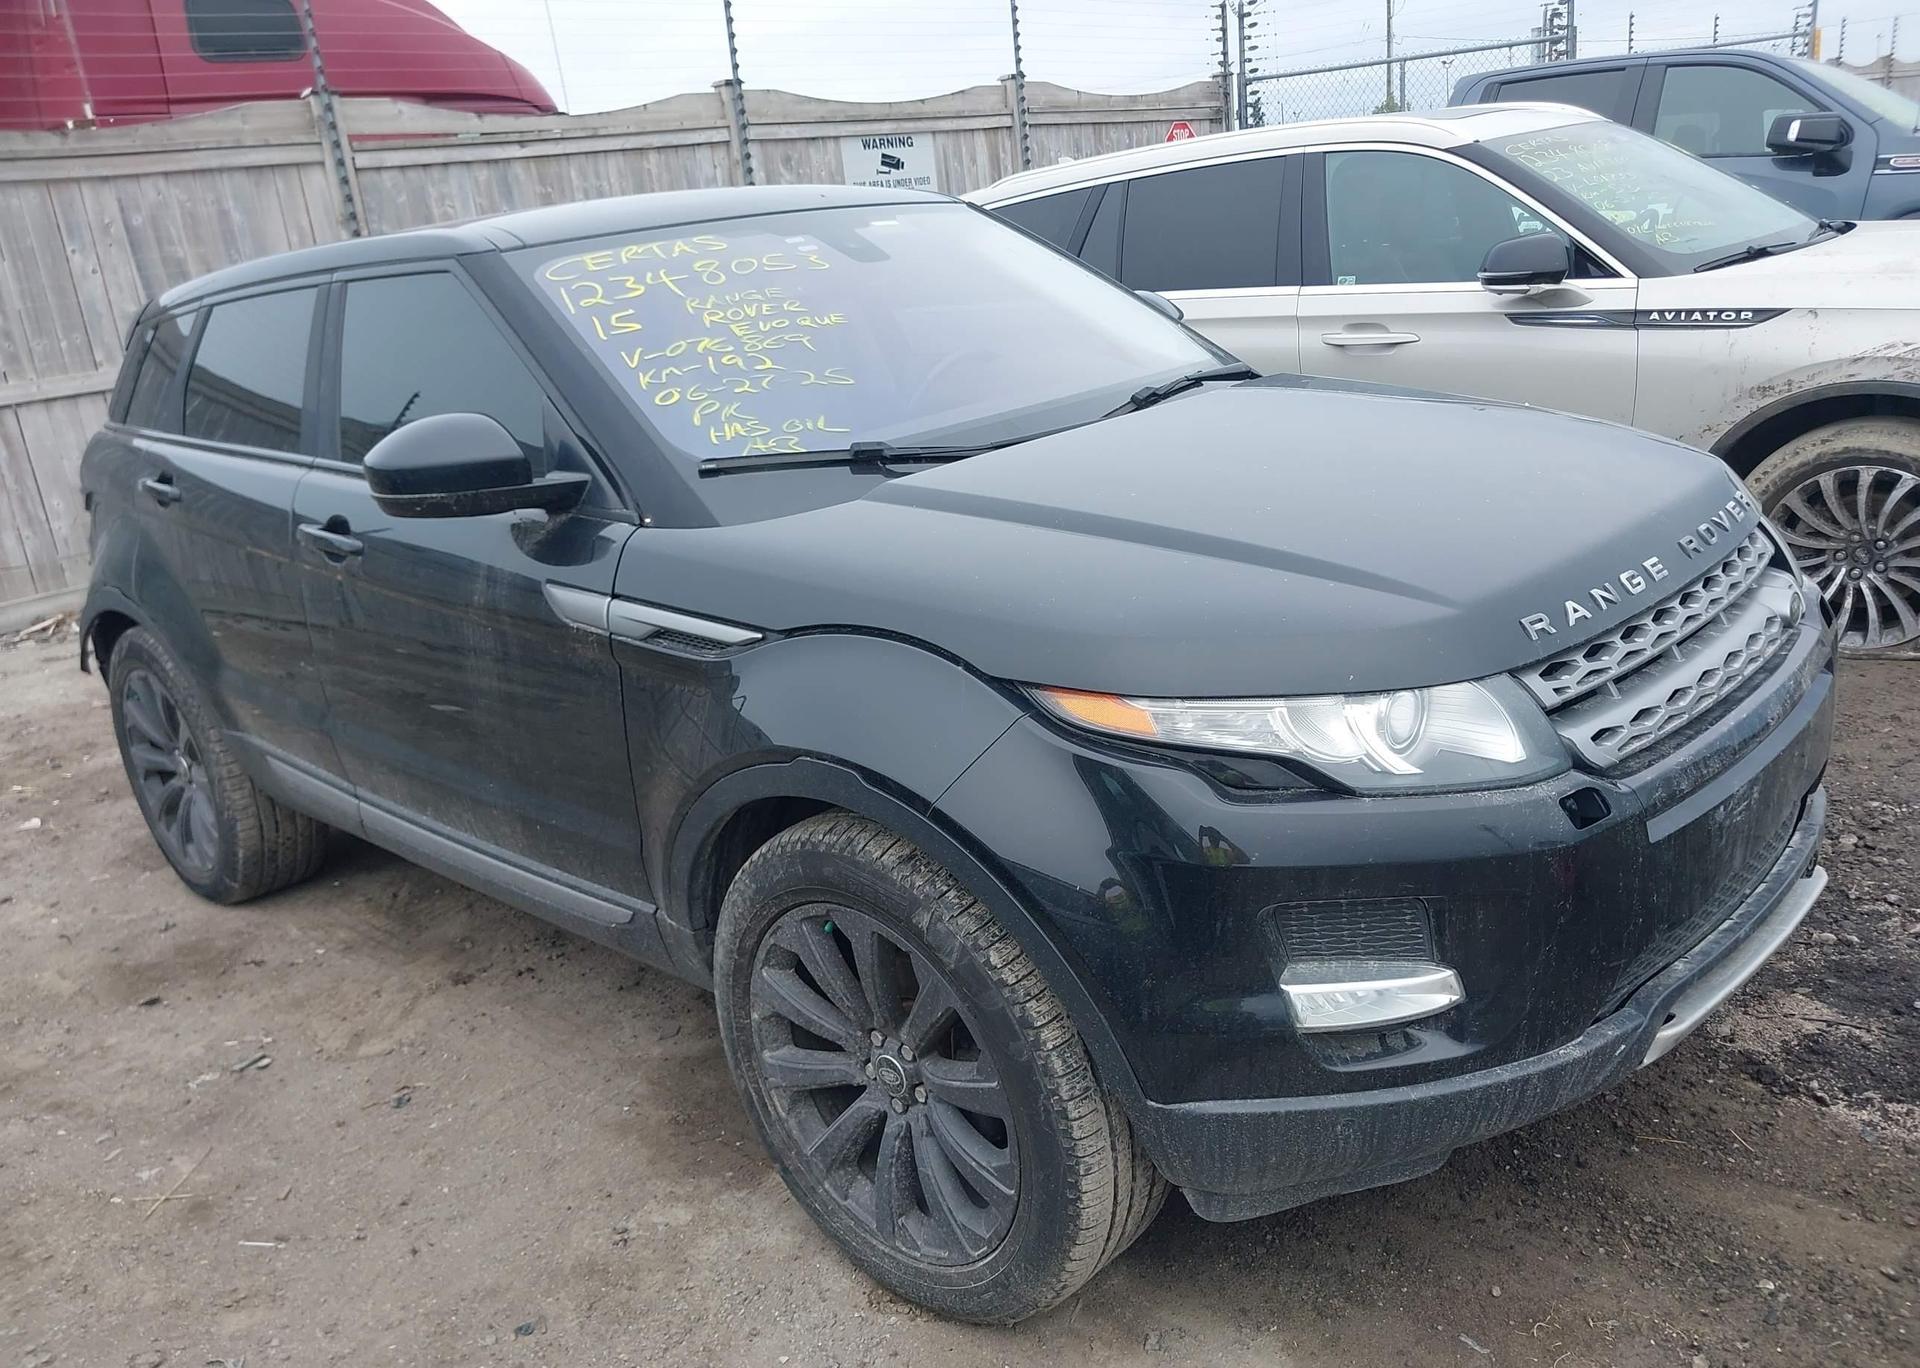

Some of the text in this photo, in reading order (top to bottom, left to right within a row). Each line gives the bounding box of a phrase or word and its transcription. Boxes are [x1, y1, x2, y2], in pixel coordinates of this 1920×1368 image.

[861, 136, 914, 150] WARNING
[1173, 129, 1190, 142] STOP
[885, 179, 892, 188] IS
[893, 178, 913, 188] UNDER
[914, 176, 931, 185] VIDEO
[545, 235, 728, 281] CERTAS
[685, 288, 786, 314] RANGE
[703, 300, 808, 328] ROVER
[591, 308, 642, 340] 15
[1649, 311, 1753, 321] AVIATOR
[710, 415, 851, 444] HAS OIL
[1519, 490, 1752, 640] RANGE ROVER
